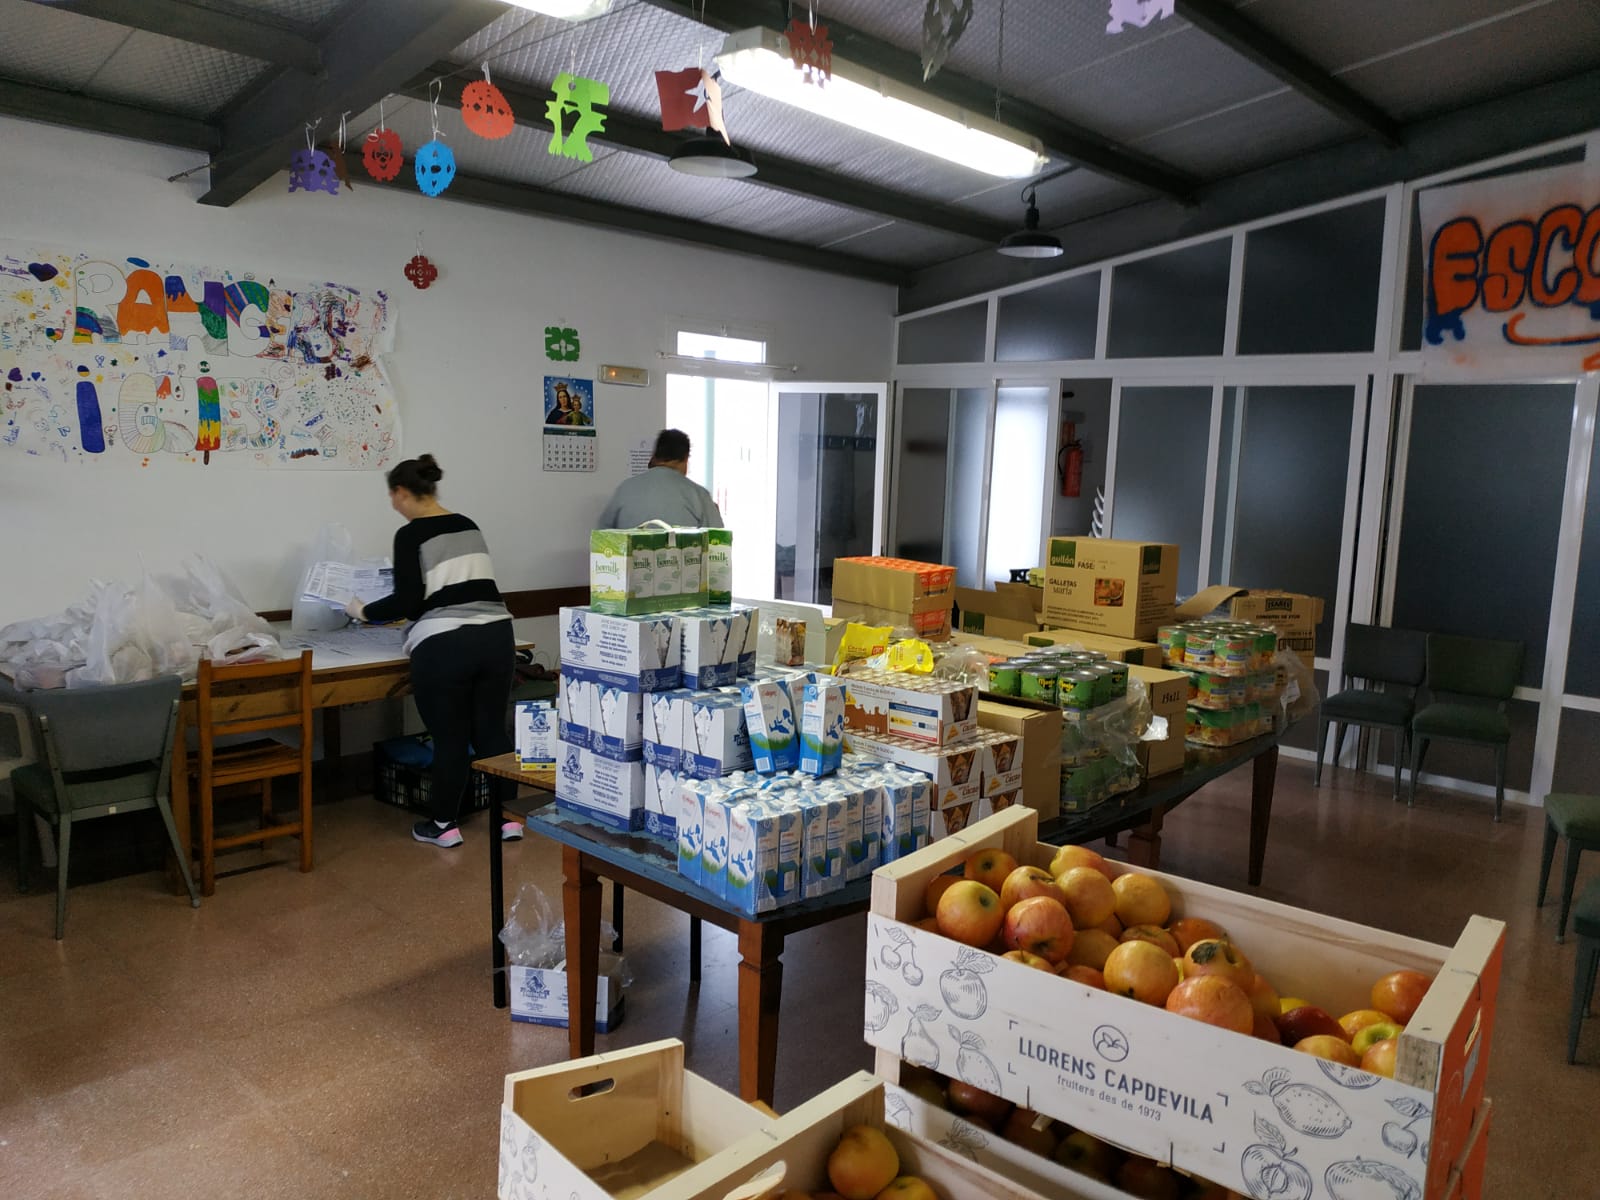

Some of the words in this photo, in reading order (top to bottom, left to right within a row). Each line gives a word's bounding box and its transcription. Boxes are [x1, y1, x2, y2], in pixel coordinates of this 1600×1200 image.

[1048, 578, 1078, 588] GALLETAS
[1018, 1036, 1096, 1081] LLORENS
[1104, 1069, 1213, 1124] CAPDEVILA
[1057, 1074, 1096, 1098] fruiters
[1098, 1090, 1117, 1105] des
[1121, 1096, 1134, 1111] de
[1138, 1104, 1162, 1122] 1973
